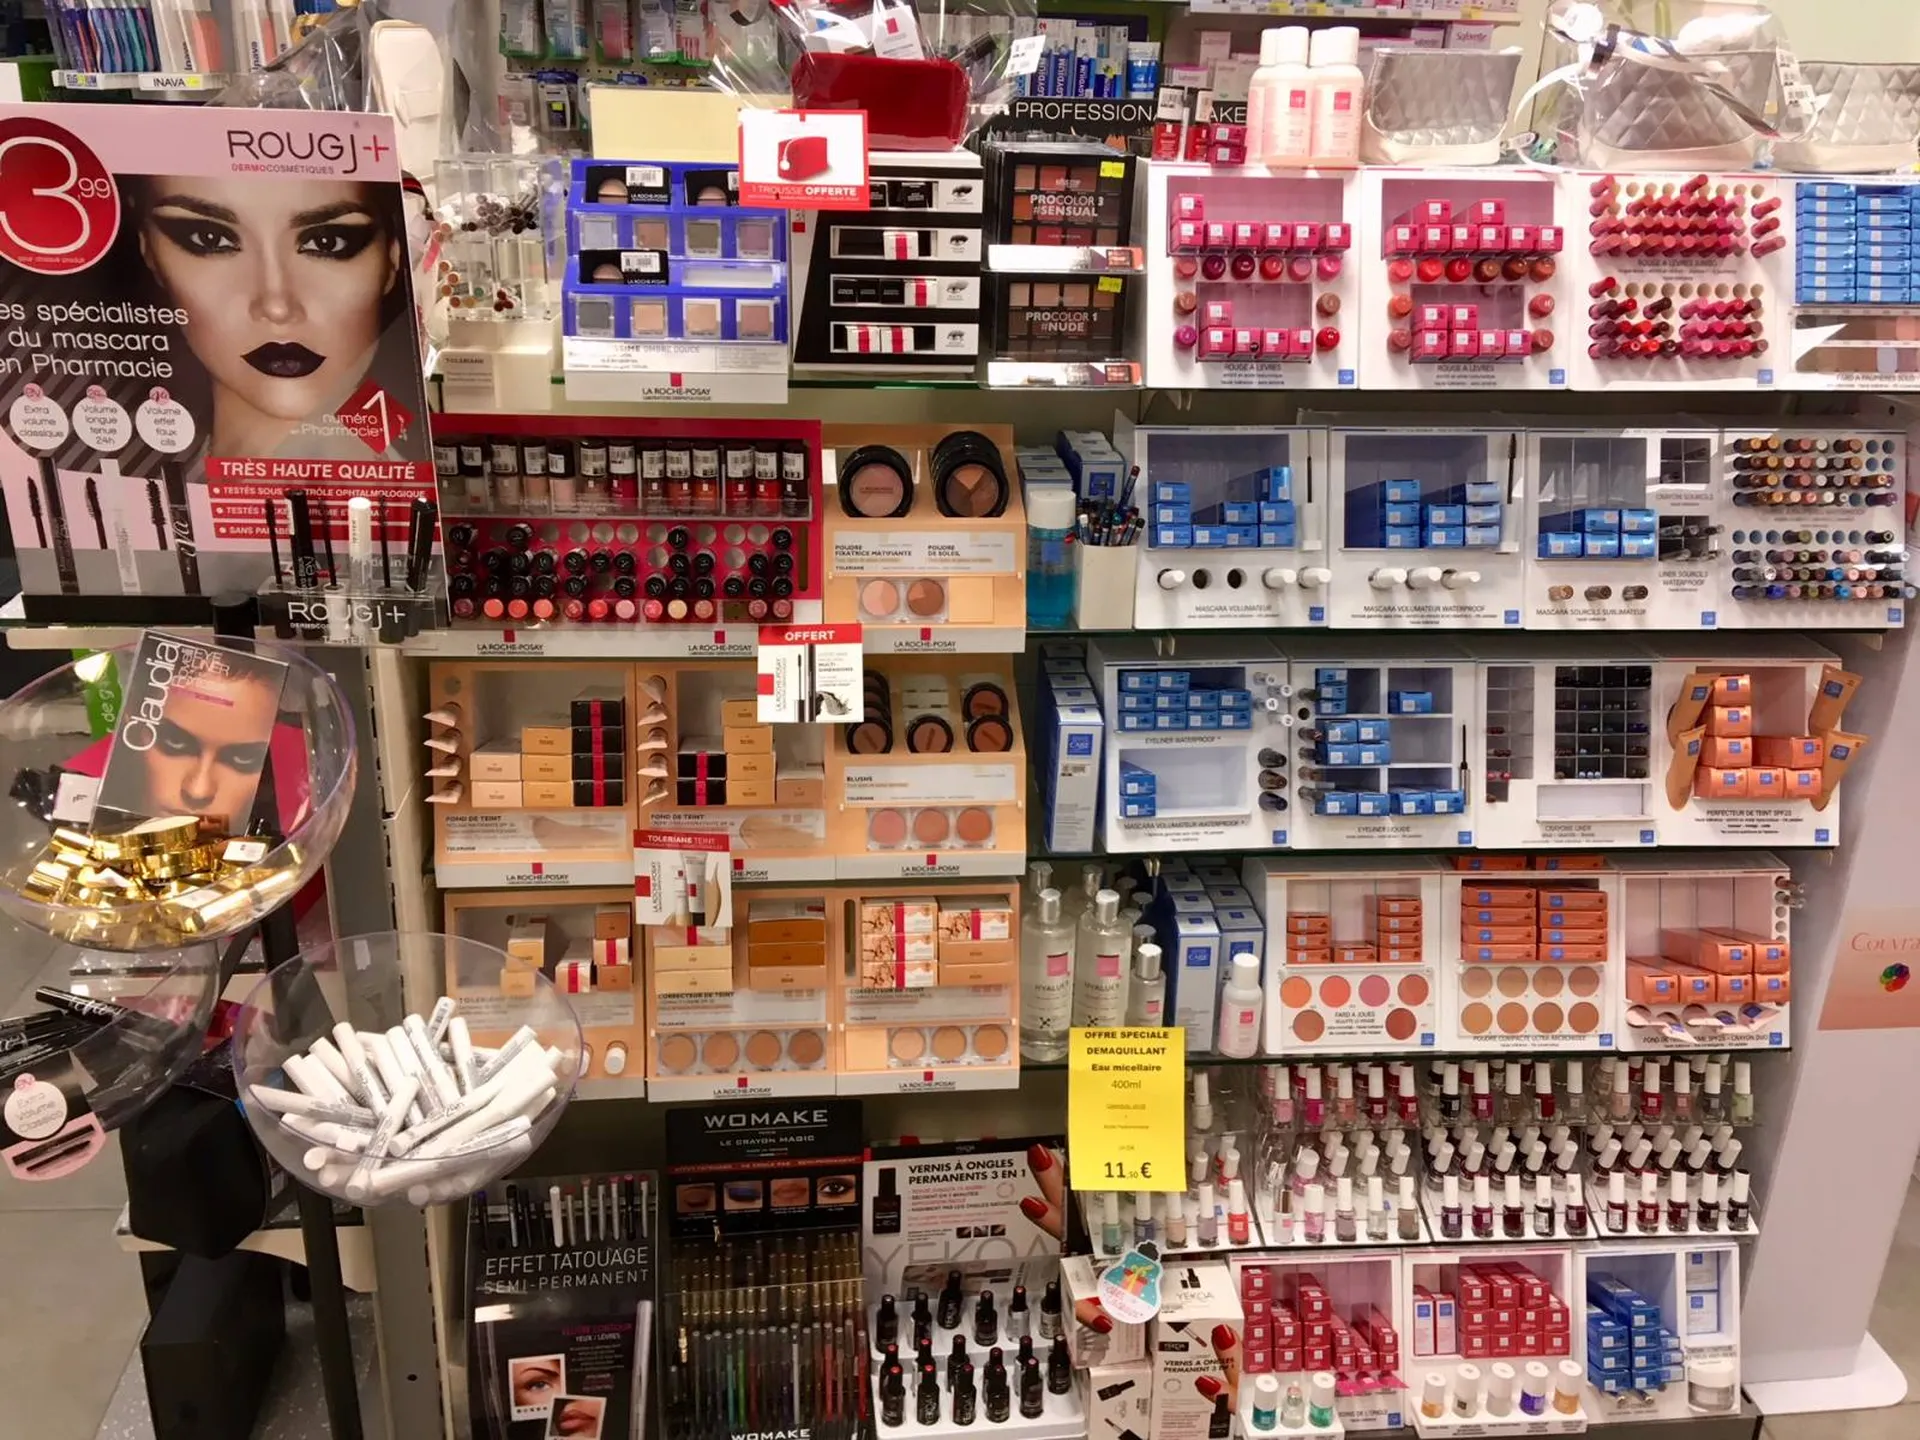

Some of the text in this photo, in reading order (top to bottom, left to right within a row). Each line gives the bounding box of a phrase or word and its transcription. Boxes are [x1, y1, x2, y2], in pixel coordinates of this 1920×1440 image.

[1037, 55, 1048, 97] LGYDIUM
[1056, 57, 1066, 97] LGYDIUM
[1077, 64, 1087, 97] LGYDIUM
[153, 78, 186, 88] INAVA
[758, 186, 857, 197] TROUSSE OFFERTE
[1030, 194, 1094, 206] PROCOLOR
[1033, 206, 1098, 217] #SENSUAL
[37, 301, 190, 325] spécialistes
[1025, 311, 1089, 321] PROCOLOR
[1041, 322, 1085, 332] #NUDE
[8, 327, 170, 351] du mascara
[32, 354, 173, 378] Pharmacie
[1224, 363, 1247, 371] ROUGE
[1437, 364, 1461, 372] ROUGE
[654, 388, 711, 396] ROCHE-POSAY
[85, 415, 118, 425] longue
[322, 413, 378, 425] numéro
[221, 457, 416, 480] TRÈS HAUTE QUALITÉ
[258, 487, 284, 496] SOUS
[1663, 579, 1705, 587] WATERPROOF
[1195, 604, 1272, 612] MASCARA VOLUMATEUR
[1363, 604, 1485, 613] MASCARA VOLUMATEUR WATERPROOF
[1536, 608, 1647, 616] MASCARA SOURCILS SUBLIMATEUR
[784, 630, 836, 642] OFFERT
[489, 644, 544, 652] ROCHE-POSAY
[906, 640, 956, 648] ROCHE-POSAY
[122, 641, 180, 751] Claudia
[1145, 735, 1216, 744] EYELINER WATERPROOF
[1706, 809, 1745, 817] PERFECTEUR
[1755, 809, 1772, 817] TEINT
[1198, 820, 1240, 828] WATERPROOF
[913, 865, 960, 873] ROCHE-POSAY
[1085, 1031, 1169, 1039] OFFRE SPECIALE
[1087, 1047, 1167, 1055] DEMAQUILLANT
[1091, 1063, 1162, 1071] Eau micellaire
[1111, 1079, 1142, 1089] 400ml
[704, 1110, 828, 1128] WOMAKE
[736, 1138, 776, 1146] CRAYON
[779, 1135, 815, 1143] MAGIC
[908, 1163, 951, 1174] VERNIS
[966, 1159, 1014, 1170] ONGLES
[908, 1173, 988, 1185] PERMANENTS
[991, 1171, 999, 1180] 3
[1001, 1170, 1018, 1179] EN
[485, 1246, 649, 1276] EFFET TATOUAGE
[484, 1269, 650, 1295] SEMI-PERMANENT
[731, 1428, 810, 1440] WOMAKE
